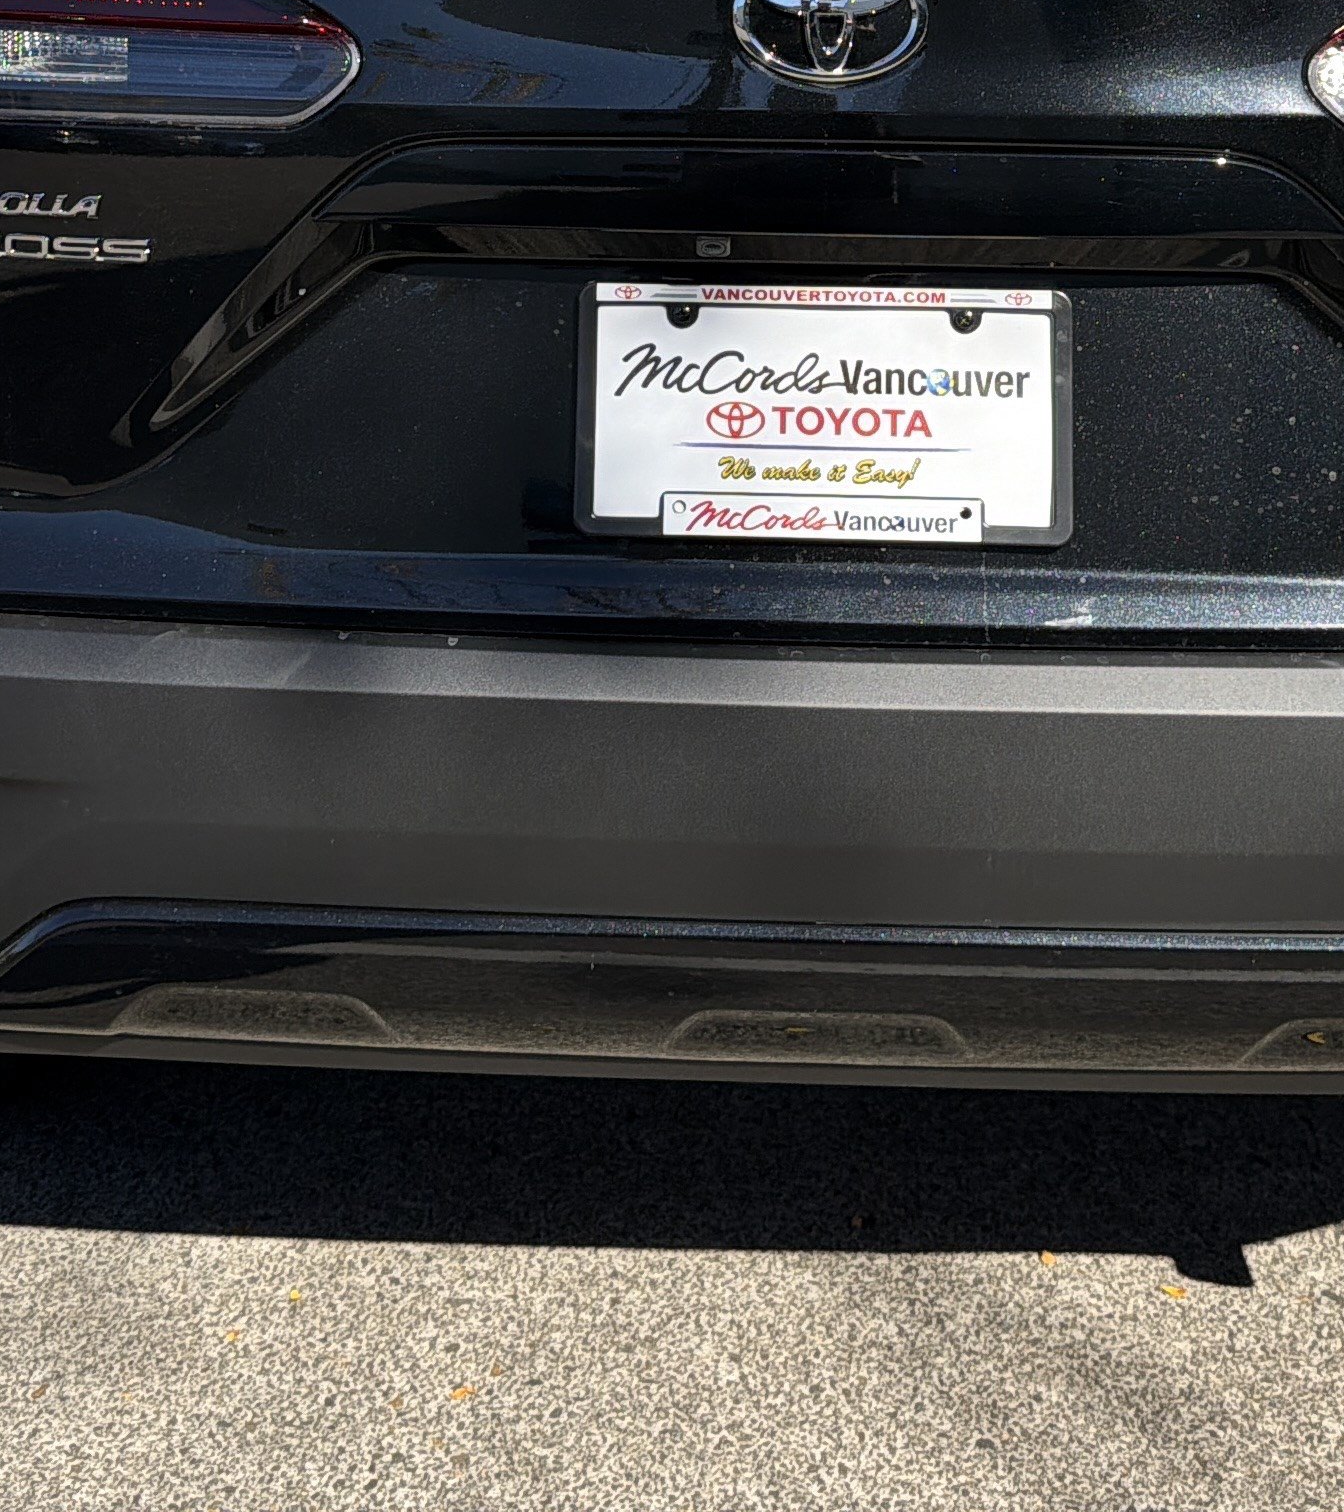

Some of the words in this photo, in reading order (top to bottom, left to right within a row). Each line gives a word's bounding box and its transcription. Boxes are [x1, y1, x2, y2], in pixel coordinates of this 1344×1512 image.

[701, 287, 947, 305] VANCOUVERTOYOTA.COM
[613, 342, 843, 397] McCords
[771, 405, 933, 438] TOYOTA
[717, 455, 757, 481] We
[761, 458, 821, 482] make
[826, 462, 847, 482] it
[852, 457, 922, 489] Easy!
[685, 500, 836, 532] McCords
